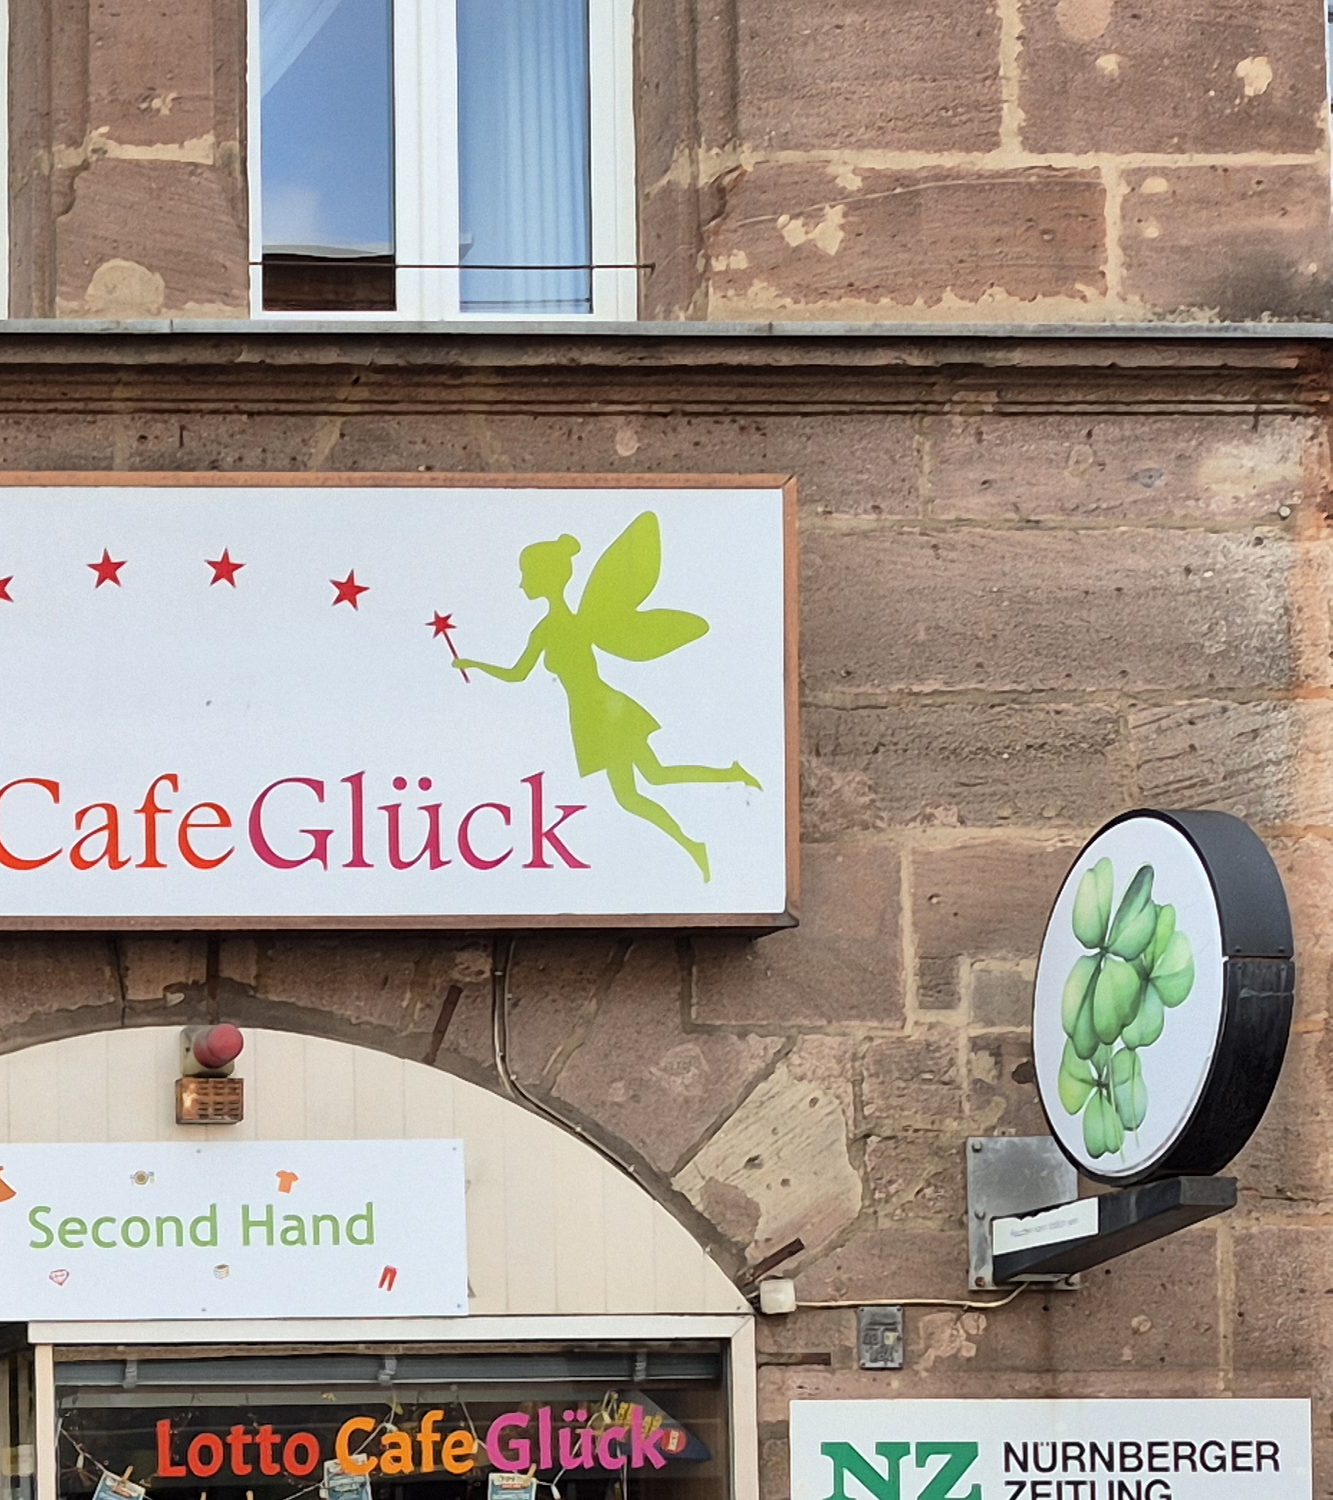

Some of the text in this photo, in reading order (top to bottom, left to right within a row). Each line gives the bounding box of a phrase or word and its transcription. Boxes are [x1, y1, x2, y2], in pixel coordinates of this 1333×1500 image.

[26, 1202, 376, 1251] Second Hand
[155, 1405, 667, 1478] Lotto Cafe Glück
[1003, 1438, 1281, 1473] NÜRNBERGER
